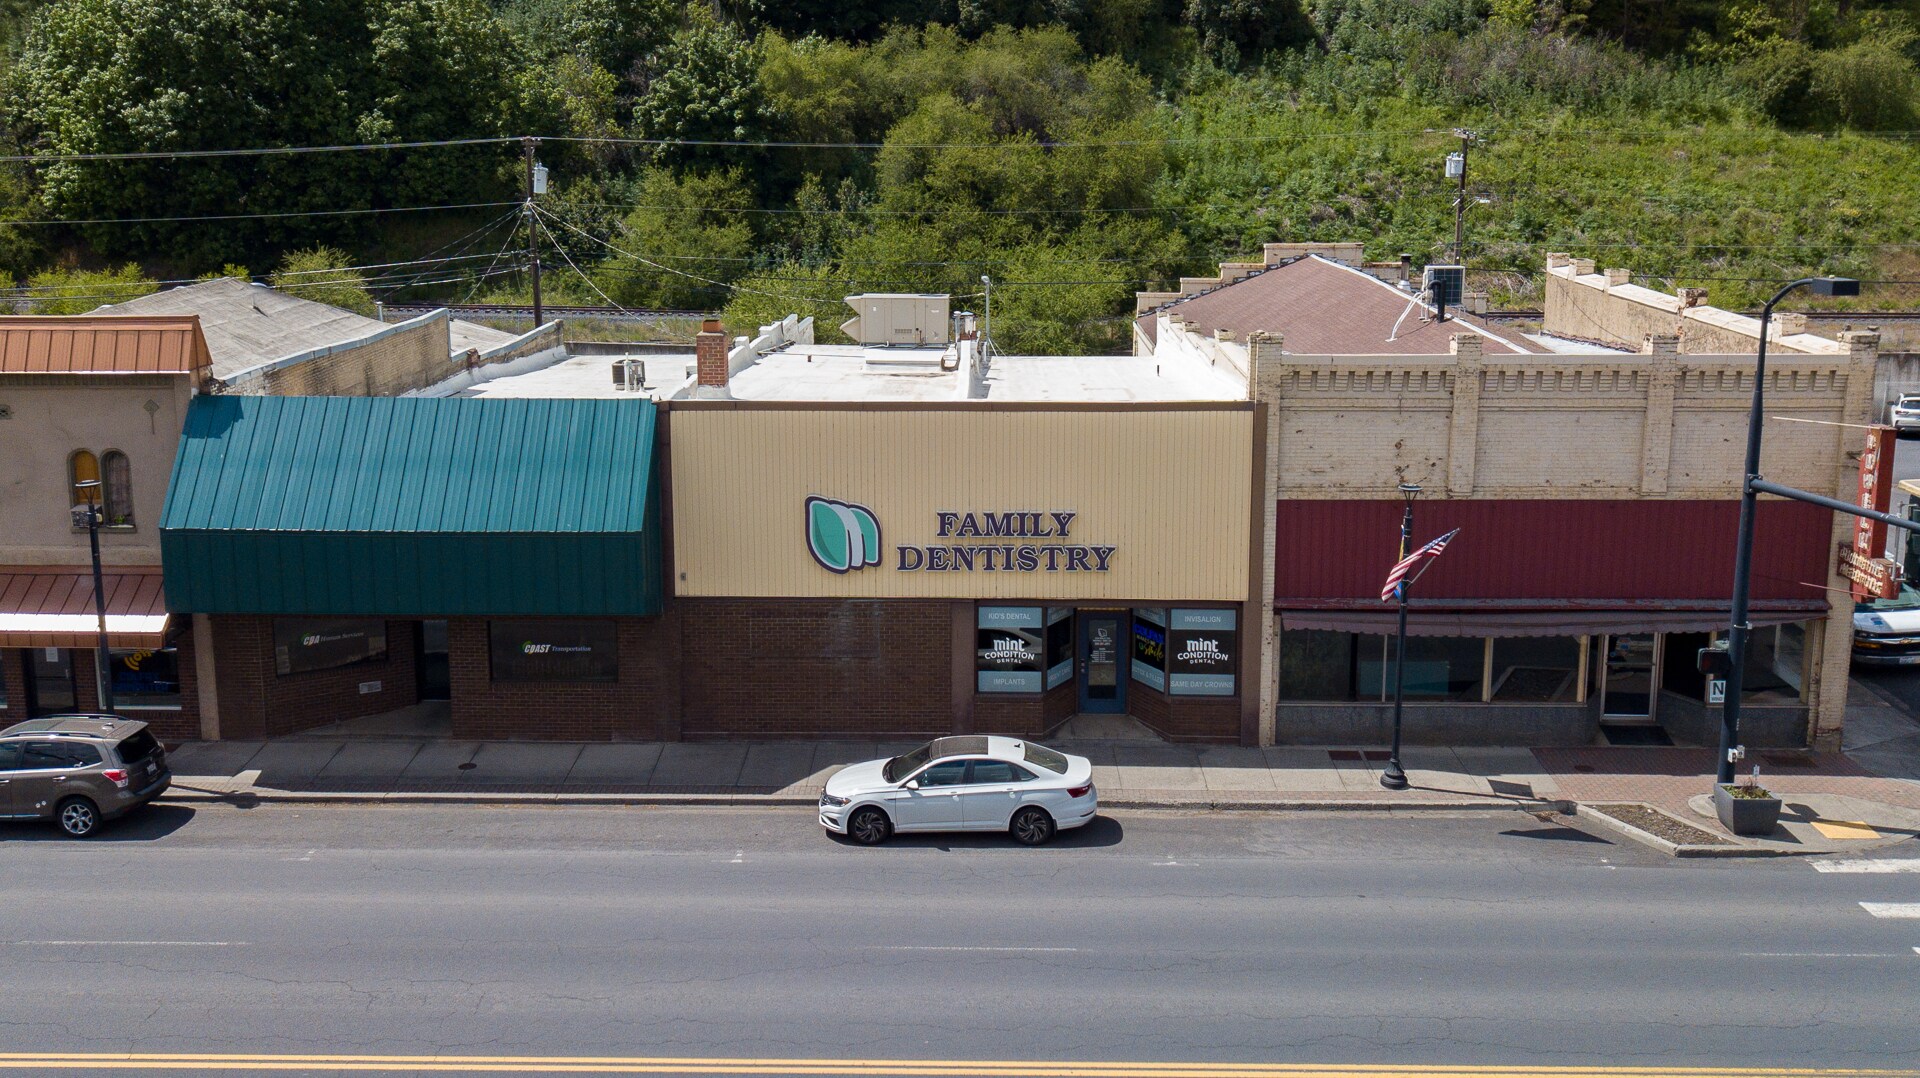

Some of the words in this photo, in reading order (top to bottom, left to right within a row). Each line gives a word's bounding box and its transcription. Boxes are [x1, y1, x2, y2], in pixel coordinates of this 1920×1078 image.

[936, 510, 1077, 538] FAMILY
[896, 543, 1117, 573] DENTISTRY
[524, 644, 551, 653] COAST
[993, 637, 1025, 651] mint
[1186, 637, 1219, 652] mint
[984, 650, 1035, 660] CONDITION
[1177, 651, 1229, 661] CONDITION
[993, 678, 1026, 686] IMPLANTS
